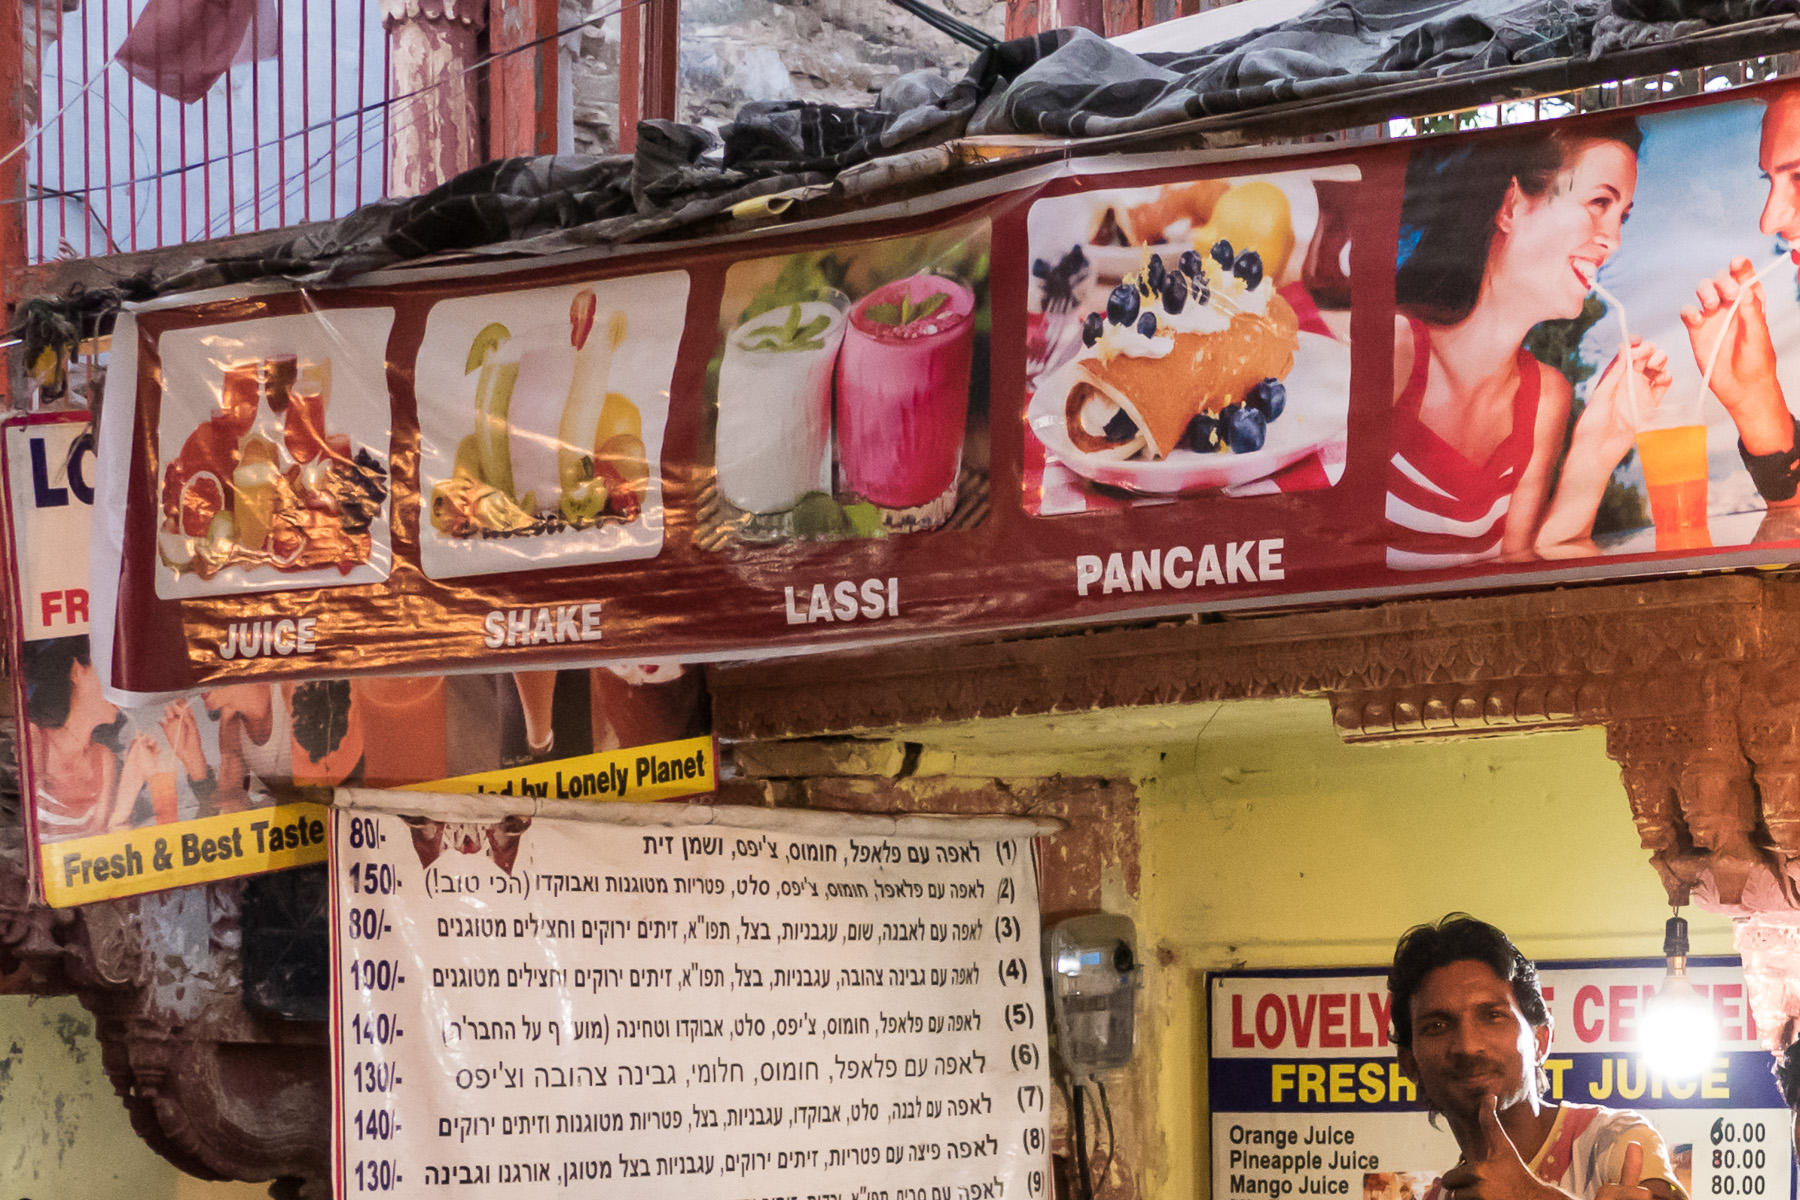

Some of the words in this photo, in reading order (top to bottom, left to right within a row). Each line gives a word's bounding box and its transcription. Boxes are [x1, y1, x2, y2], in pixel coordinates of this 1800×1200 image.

[1076, 539, 1285, 596] PANCAKE
[784, 577, 898, 625] LASSI
[484, 603, 603, 649] SHAKE
[219, 617, 318, 661] JUICE
[555, 762, 628, 800] Lonely
[636, 750, 705, 786] Planet
[350, 817, 386, 850] 80/-
[643, 835, 674, 855] זית
[62, 845, 147, 888] Fresh
[152, 838, 174, 873] &
[181, 829, 247, 869] Best
[252, 814, 325, 853] Taste
[682, 836, 723, 861] ושמן
[785, 842, 837, 864] חומוס,
[844, 840, 901, 866] פלאפל,
[908, 845, 930, 864] עם
[937, 841, 980, 863] לאפה
[996, 838, 1017, 864] (1)
[350, 862, 402, 895] 150/-
[536, 874, 599, 893] ואבוקדו
[606, 876, 669, 894] מטוגנות
[675, 876, 724, 896] פטריות
[731, 875, 770, 898] סלט,
[825, 880, 869, 901] חומוס,
[874, 880, 924, 901] פלאפל,
[928, 882, 945, 898] עם
[950, 880, 984, 899] לאפה
[997, 877, 1015, 904] (2)
[349, 908, 392, 940] 80/-
[437, 917, 507, 938] מטוגנים
[582, 919, 630, 945] ירוקים
[638, 919, 677, 939] זיתים
[736, 916, 771, 944] בצל,
[931, 923, 947, 941] עם
[952, 918, 983, 941] לאפה
[995, 916, 1020, 943] (3)
[350, 959, 405, 991] 100/-
[352, 1013, 404, 1045] 140/-
[1230, 991, 1393, 1049] LOVELY
[353, 1061, 402, 1093] 130/-
[1271, 1063, 1417, 1103] FRESH
[354, 1109, 402, 1141] 140/-
[1230, 1125, 1298, 1149] Orange
[1303, 1126, 1355, 1146] Juice
[1230, 1150, 1322, 1173] Pineapple
[1328, 1151, 1379, 1170] Juice
[1712, 1149, 1766, 1169] 80.00
[355, 1159, 402, 1191] 130/-
[1230, 1175, 1293, 1198] Mango
[1298, 1176, 1349, 1195] Juice
[1711, 1175, 1766, 1195] 80.00
